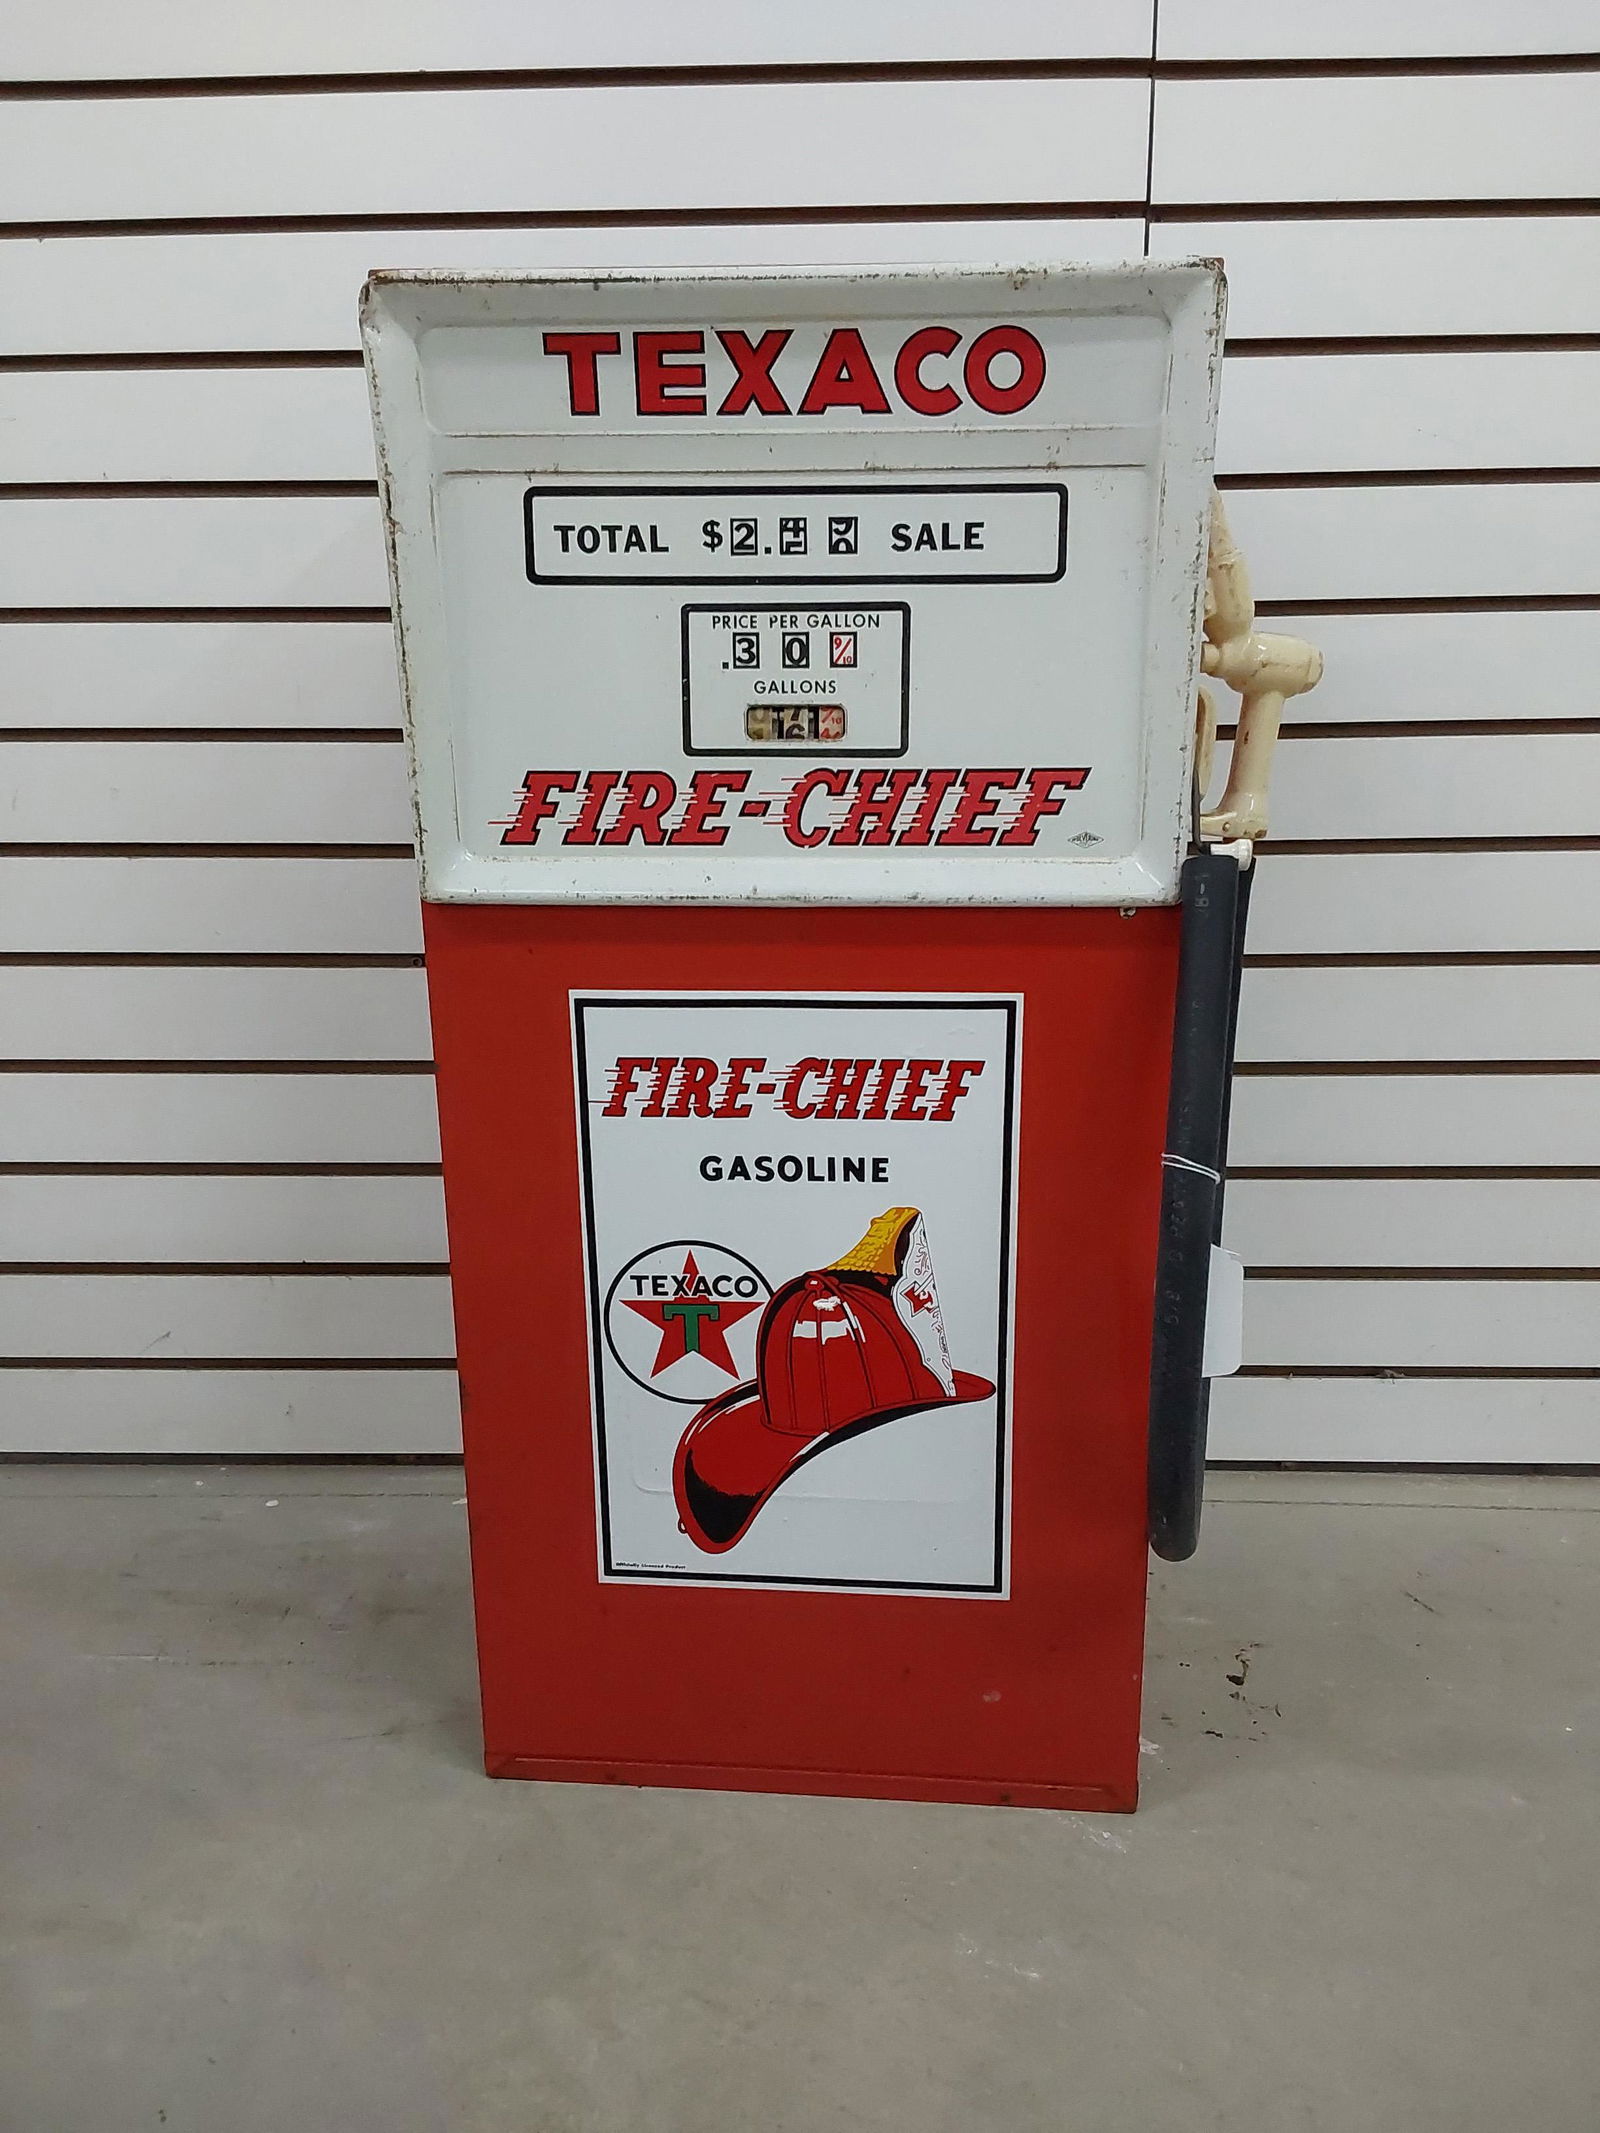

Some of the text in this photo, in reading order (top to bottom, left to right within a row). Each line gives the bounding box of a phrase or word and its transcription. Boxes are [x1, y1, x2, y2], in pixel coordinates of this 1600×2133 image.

[542, 325, 1046, 417] TEXACO
[553, 524, 669, 554] TOTAL
[890, 521, 985, 551] SALE
[712, 614, 880, 629] PRICE PER GALLON
[754, 680, 836, 694] GALLONS
[497, 767, 1092, 847] FIRE-CHIEF
[602, 1057, 986, 1121] FIRE-CHIEF
[700, 1155, 889, 1182] GASOLINE
[630, 1275, 758, 1298] TEXACO
